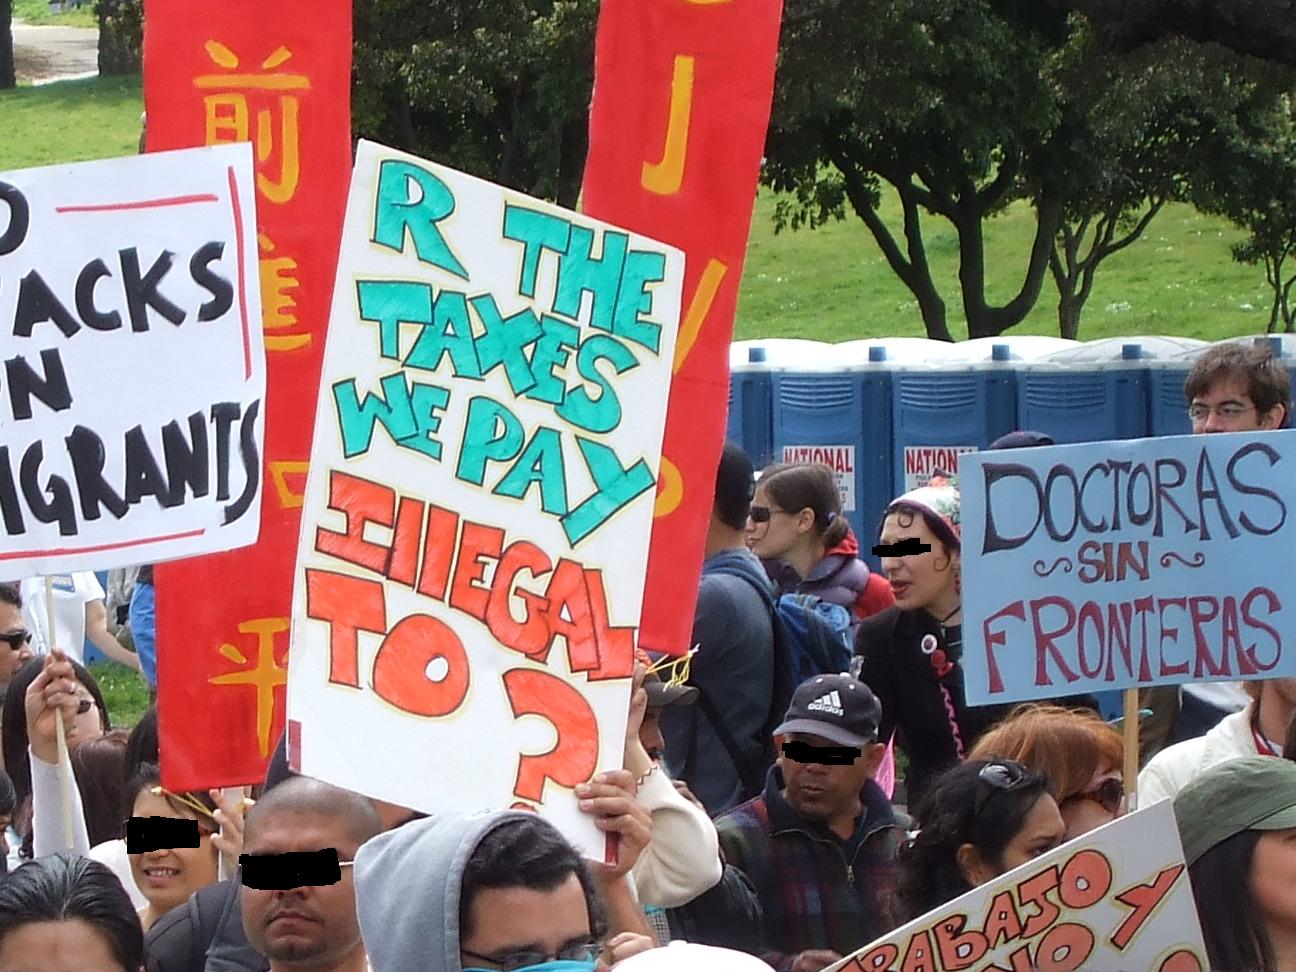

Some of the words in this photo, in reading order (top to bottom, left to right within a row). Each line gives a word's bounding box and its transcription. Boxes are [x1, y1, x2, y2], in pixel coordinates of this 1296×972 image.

[368, 158, 470, 281] R
[502, 199, 667, 354] THE
[355, 279, 638, 434] TAXES
[332, 376, 450, 460] WE
[456, 394, 657, 548] PAY
[906, 449, 973, 474] NATION
[981, 441, 1287, 556] DOCTORAS
[1077, 540, 1150, 584] SIN
[305, 567, 471, 718] TO
[982, 586, 1283, 694] FRONTERAS
[808, 702, 844, 717] adidas
[1109, 863, 1185, 950] Y
